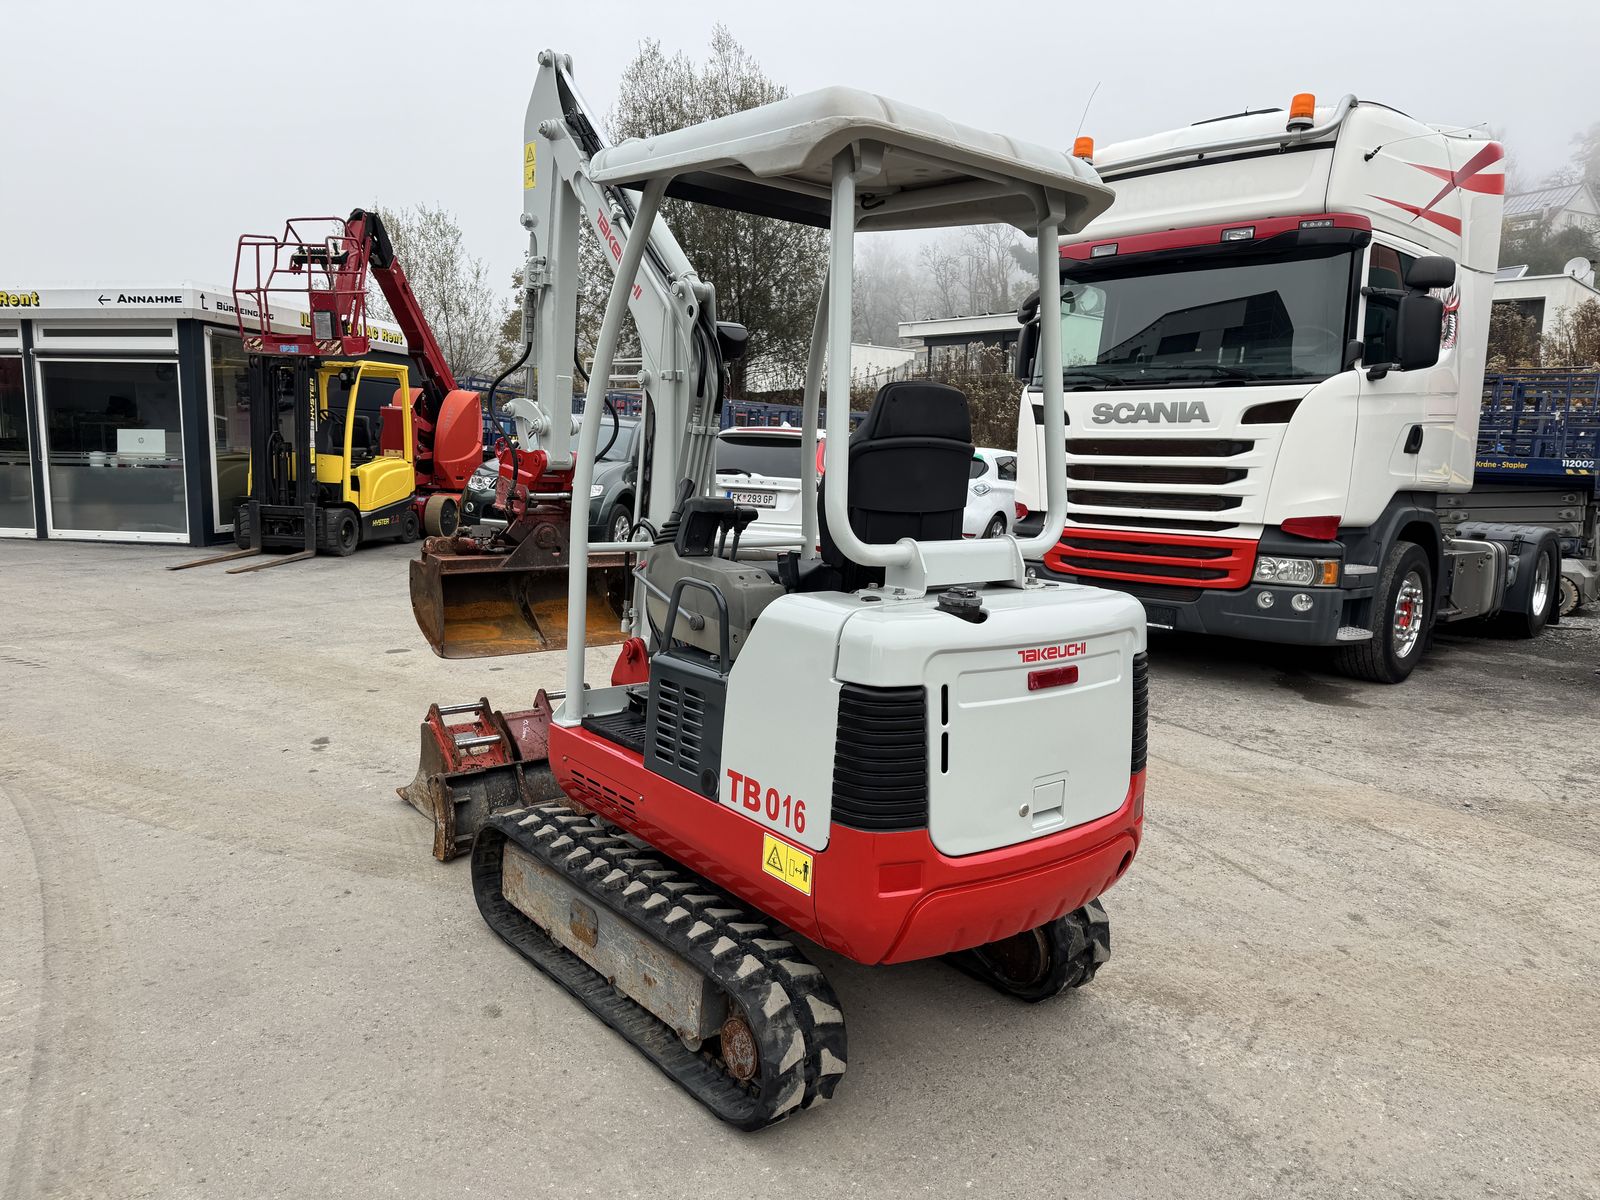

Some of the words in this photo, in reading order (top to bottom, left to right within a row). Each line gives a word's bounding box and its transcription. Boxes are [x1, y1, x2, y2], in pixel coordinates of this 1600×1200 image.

[0, 290, 40, 307] Rent
[117, 293, 183, 304] ANNAHME
[382, 328, 403, 345] Rent
[1091, 401, 1211, 425] SCANIA
[1561, 459, 1595, 469] 112002
[747, 494, 762, 503] 293
[763, 495, 773, 504] GP
[372, 517, 390, 526] HYSTER
[1017, 642, 1087, 663] TAKEUCHI
